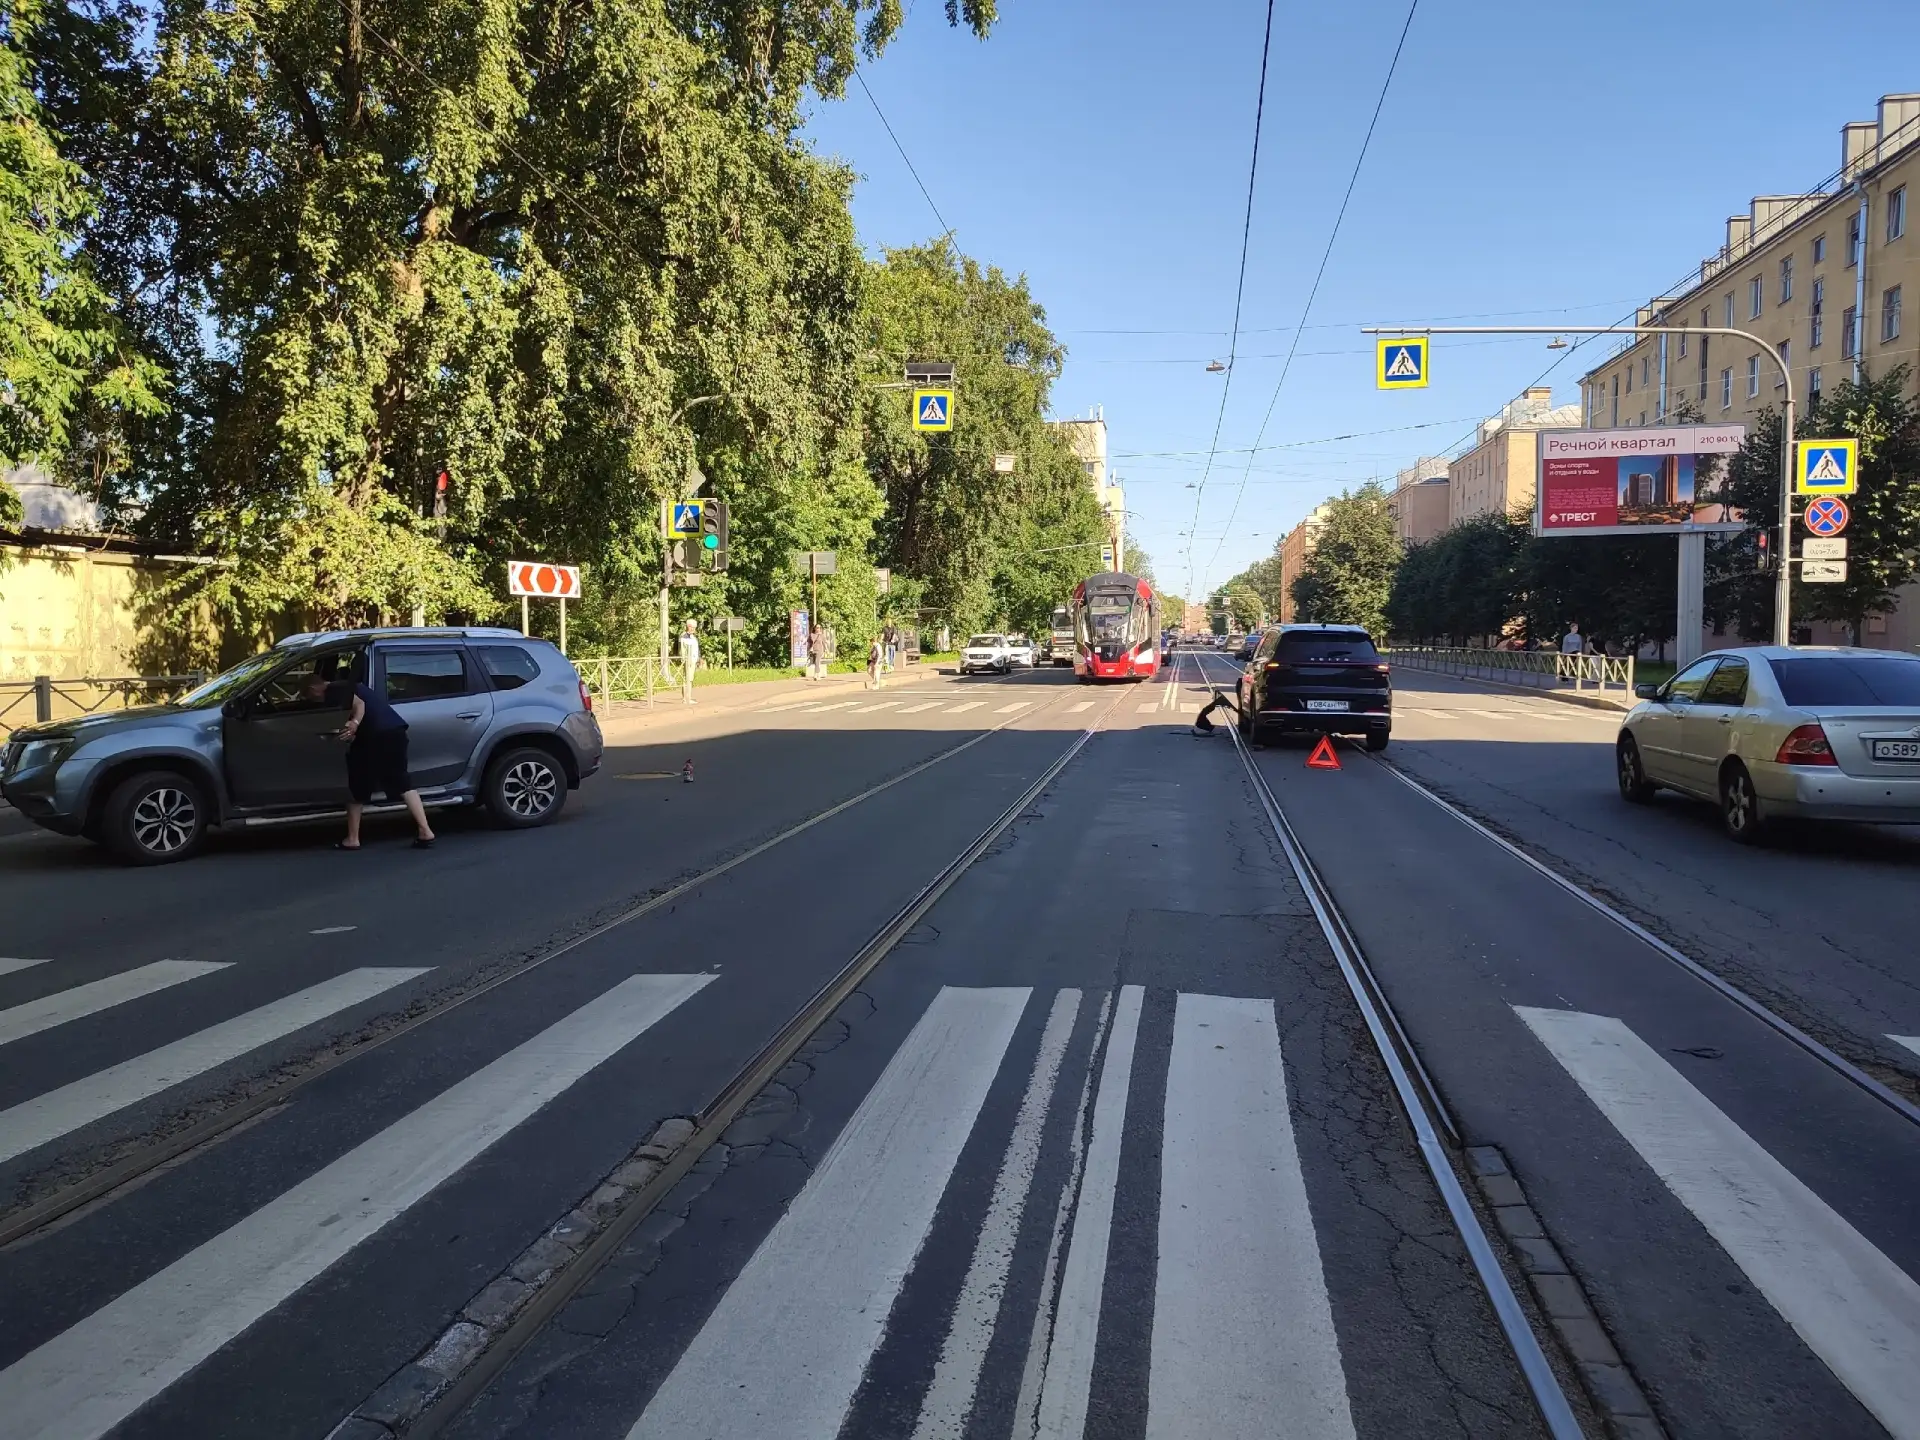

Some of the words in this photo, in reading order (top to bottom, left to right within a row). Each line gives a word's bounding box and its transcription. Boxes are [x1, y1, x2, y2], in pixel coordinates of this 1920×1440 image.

[1549, 437, 1607, 452] Речной
[1611, 437, 1676, 451] квартал
[1700, 436, 1715, 444] 210
[1730, 435, 1739, 443] 10
[1559, 512, 1597, 522] ТРЕСТ
